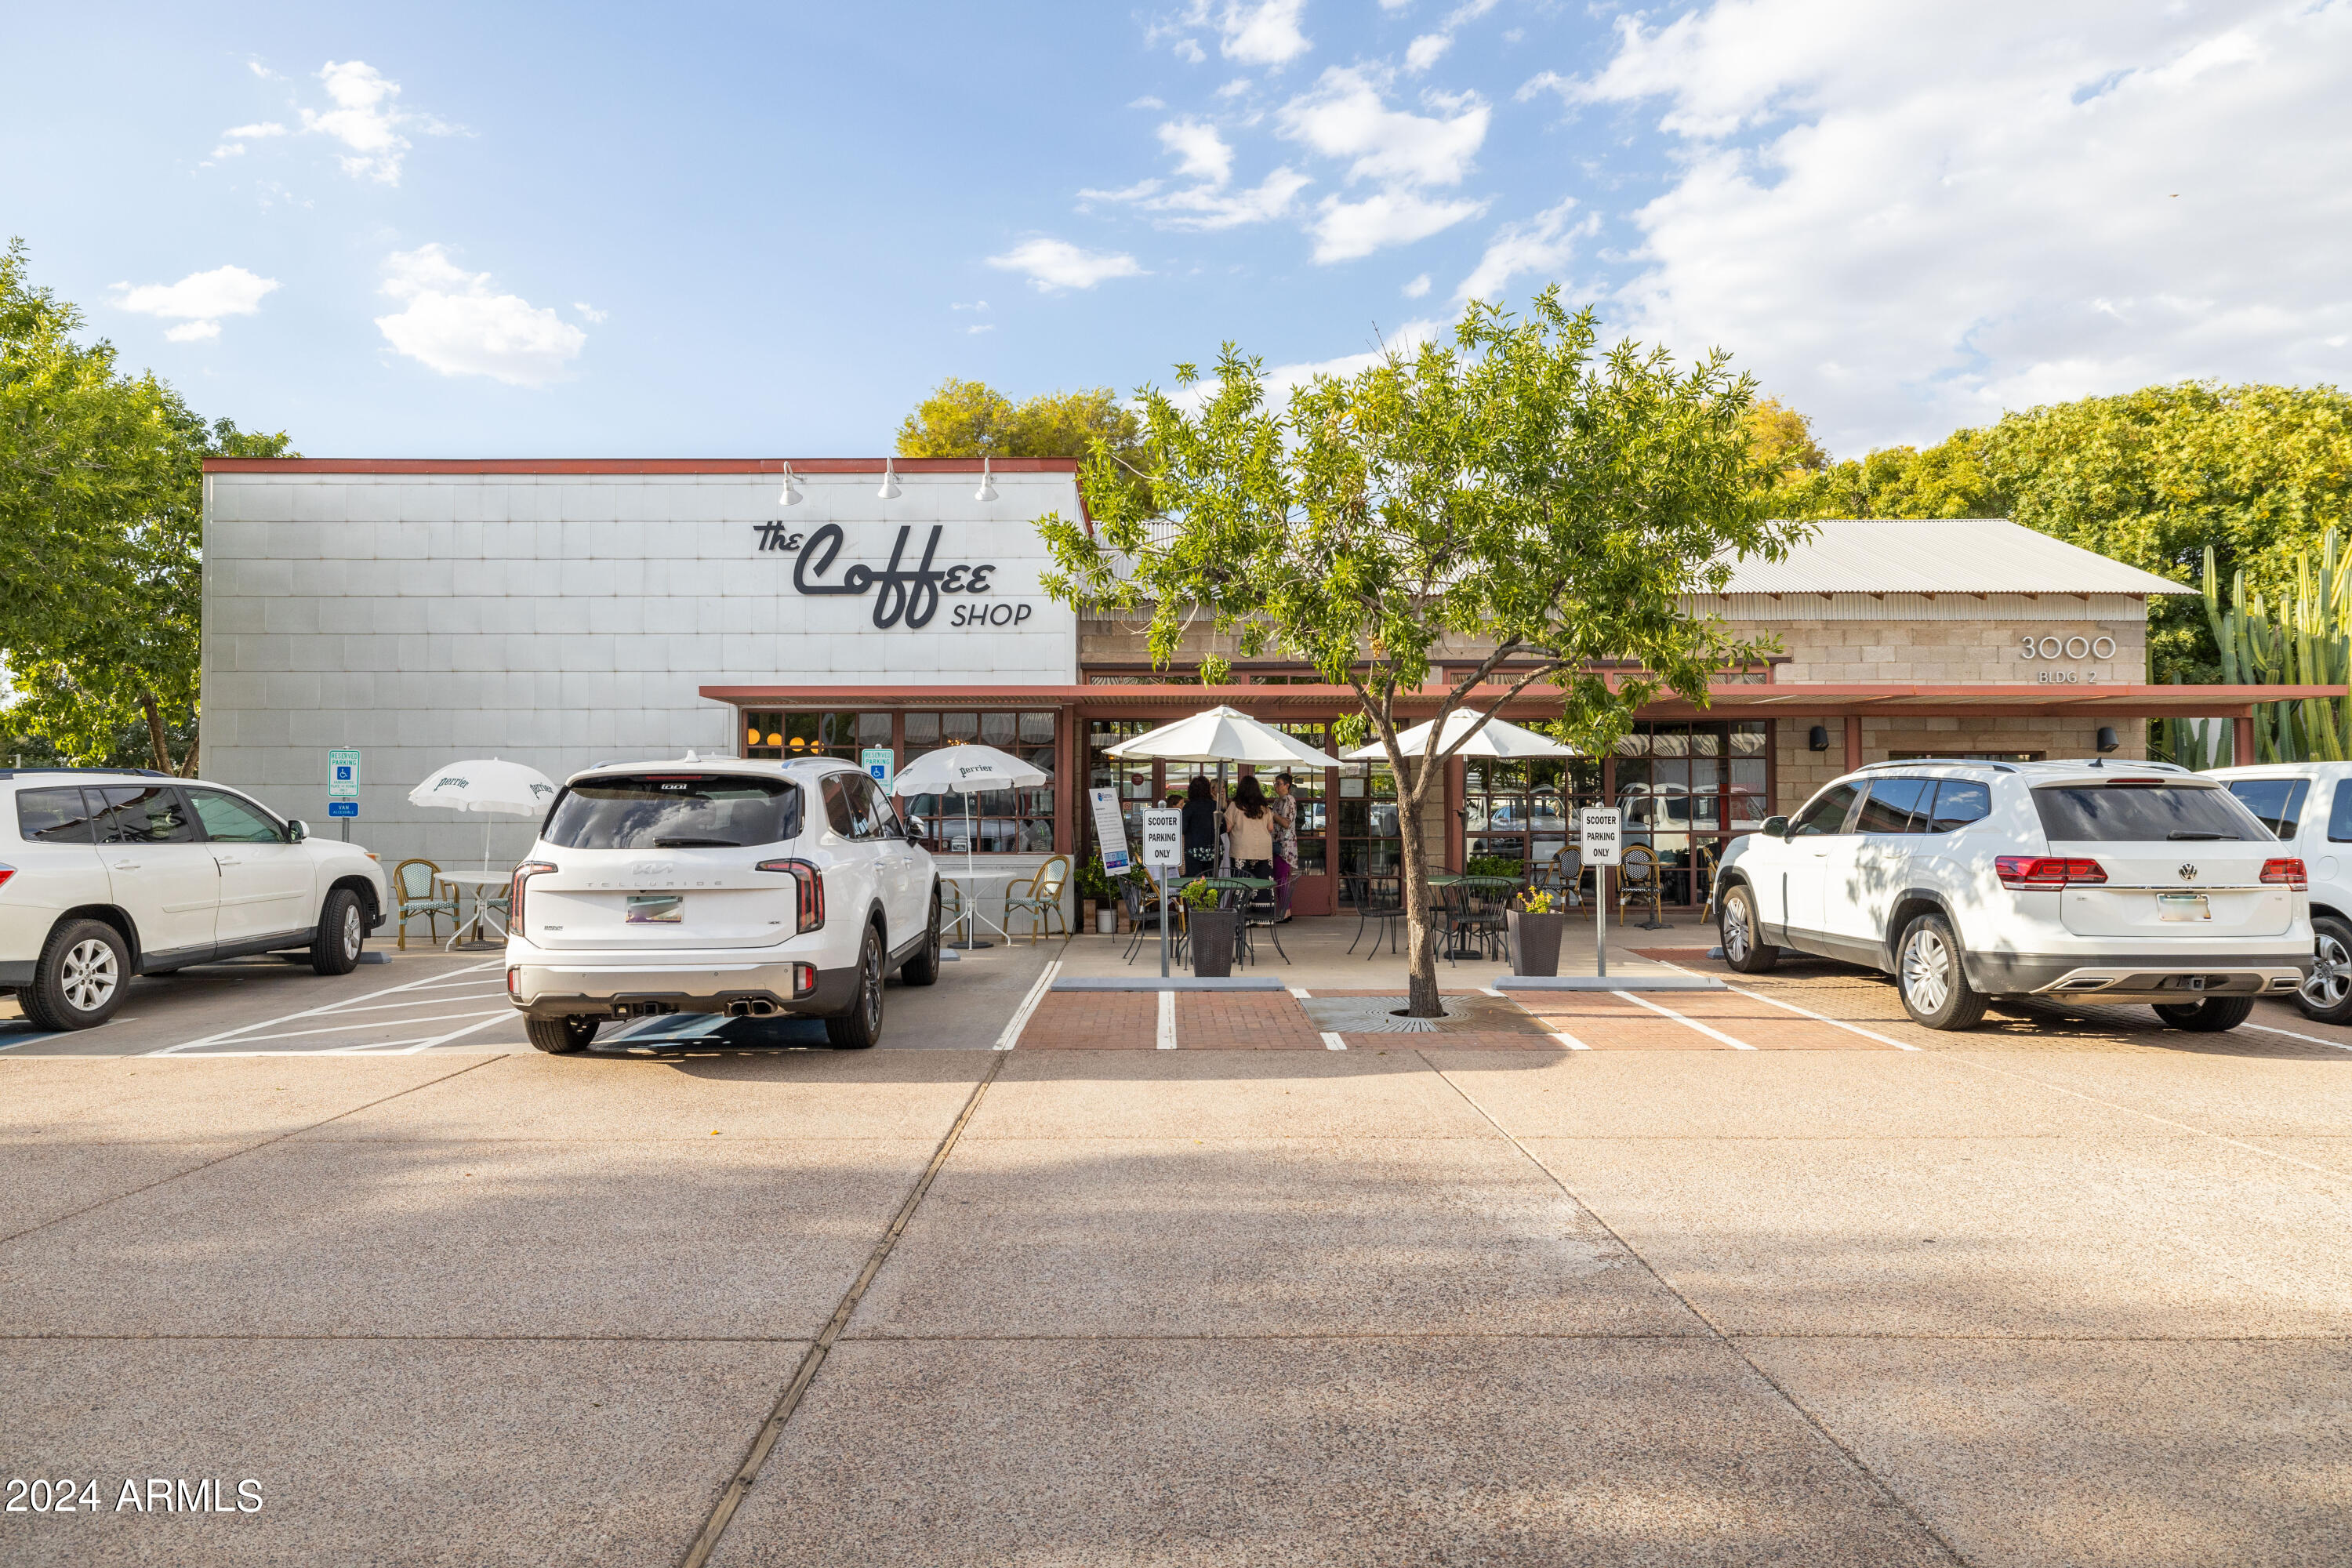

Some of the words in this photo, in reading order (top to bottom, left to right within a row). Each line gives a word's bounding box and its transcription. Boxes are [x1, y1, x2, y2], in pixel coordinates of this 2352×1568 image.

[950, 603, 1032, 627] SHOP
[2022, 636, 2116, 659] 3000
[2089, 671, 2097, 683] 2
[1148, 817, 1178, 826] SCOOTER
[1586, 816, 1617, 825] SCOOTER
[1149, 833, 1176, 842] PARKING
[1587, 832, 1615, 841] PARKING
[1154, 849, 1171, 858] ONLY
[1593, 848, 1610, 857] ONLY
